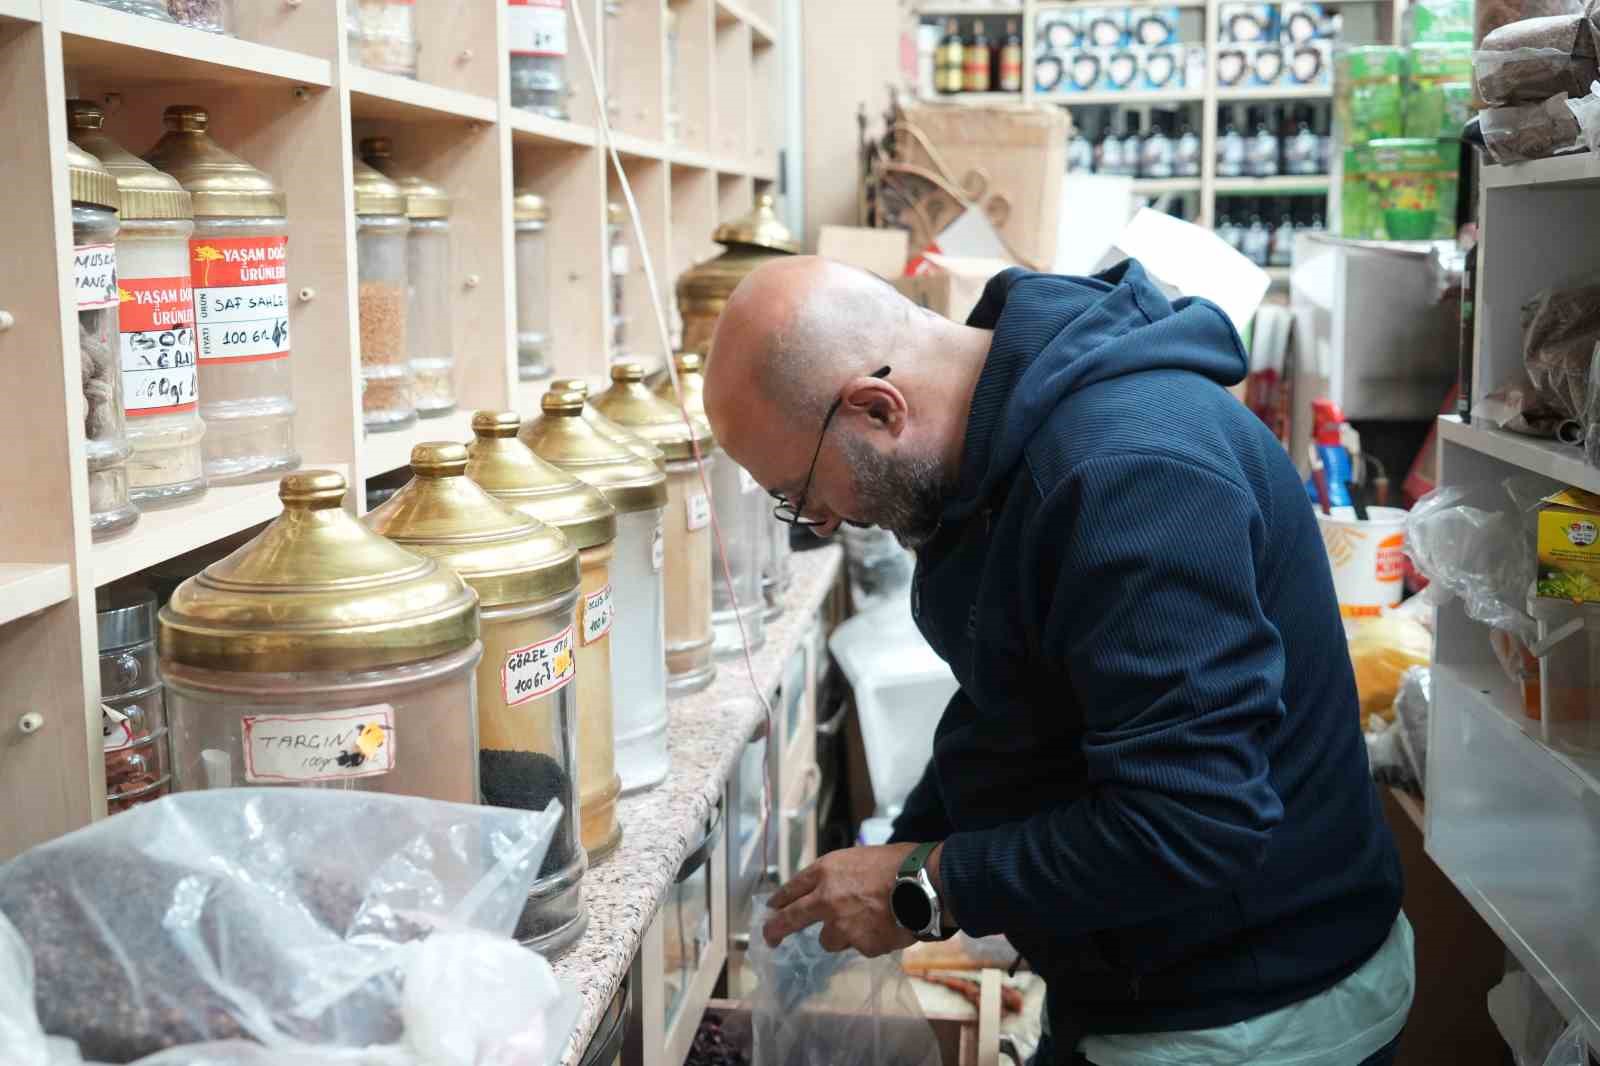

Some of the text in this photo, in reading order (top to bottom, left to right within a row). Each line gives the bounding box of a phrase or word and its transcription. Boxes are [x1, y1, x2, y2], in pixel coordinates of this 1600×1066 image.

[223, 248, 264, 264] YAŞAM
[135, 288, 176, 305] YAŞAM
[223, 331, 247, 345] 100
